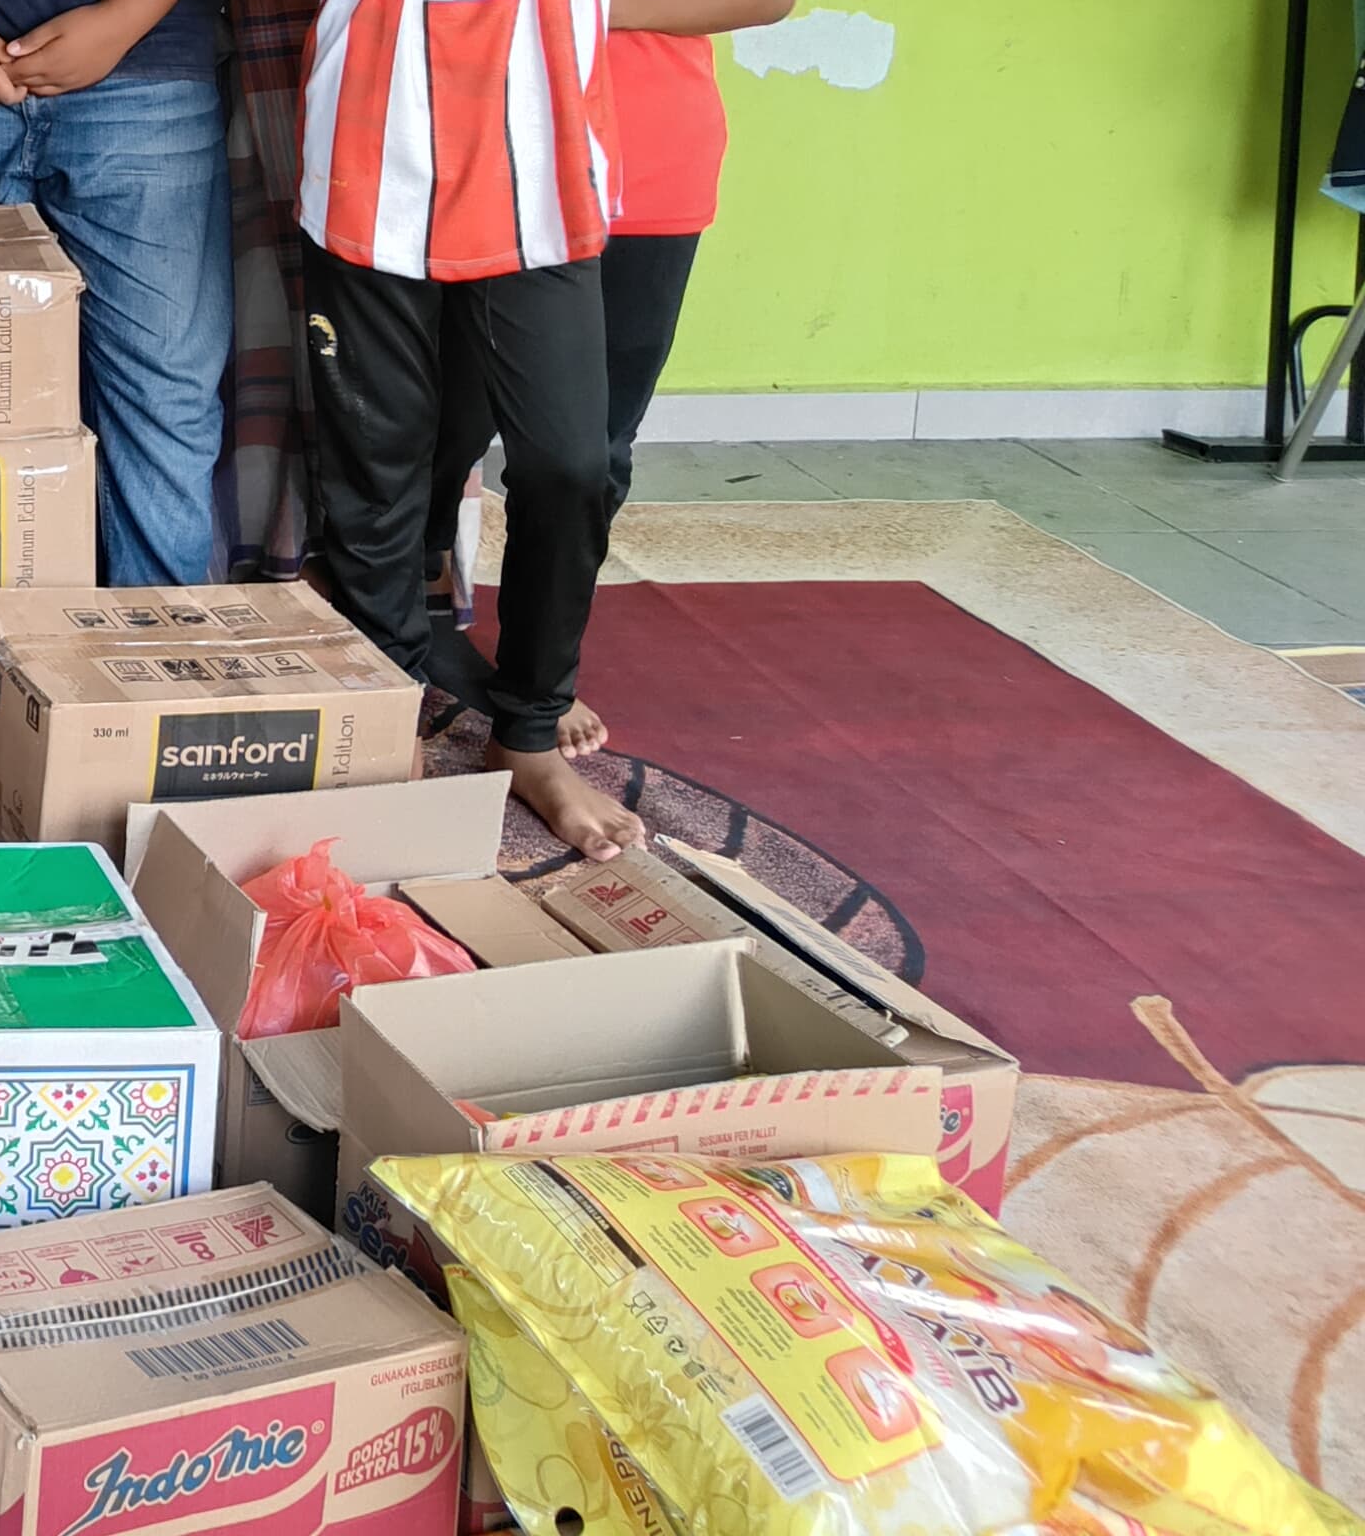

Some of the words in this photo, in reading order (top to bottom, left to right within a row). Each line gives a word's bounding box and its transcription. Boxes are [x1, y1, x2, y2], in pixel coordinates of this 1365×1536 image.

[93, 726, 113, 738] 330
[115, 727, 129, 738] ml
[161, 733, 307, 767] sanford
[332, 714, 355, 776] Edition
[564, 1184, 611, 1231] PREMIUM
[370, 1364, 418, 1387] GUNAKAN
[352, 1427, 401, 1464] PORSI
[402, 1409, 445, 1468] 15%
[61, 1421, 307, 1536] Indomie
[338, 1451, 400, 1490] EKSTRA
